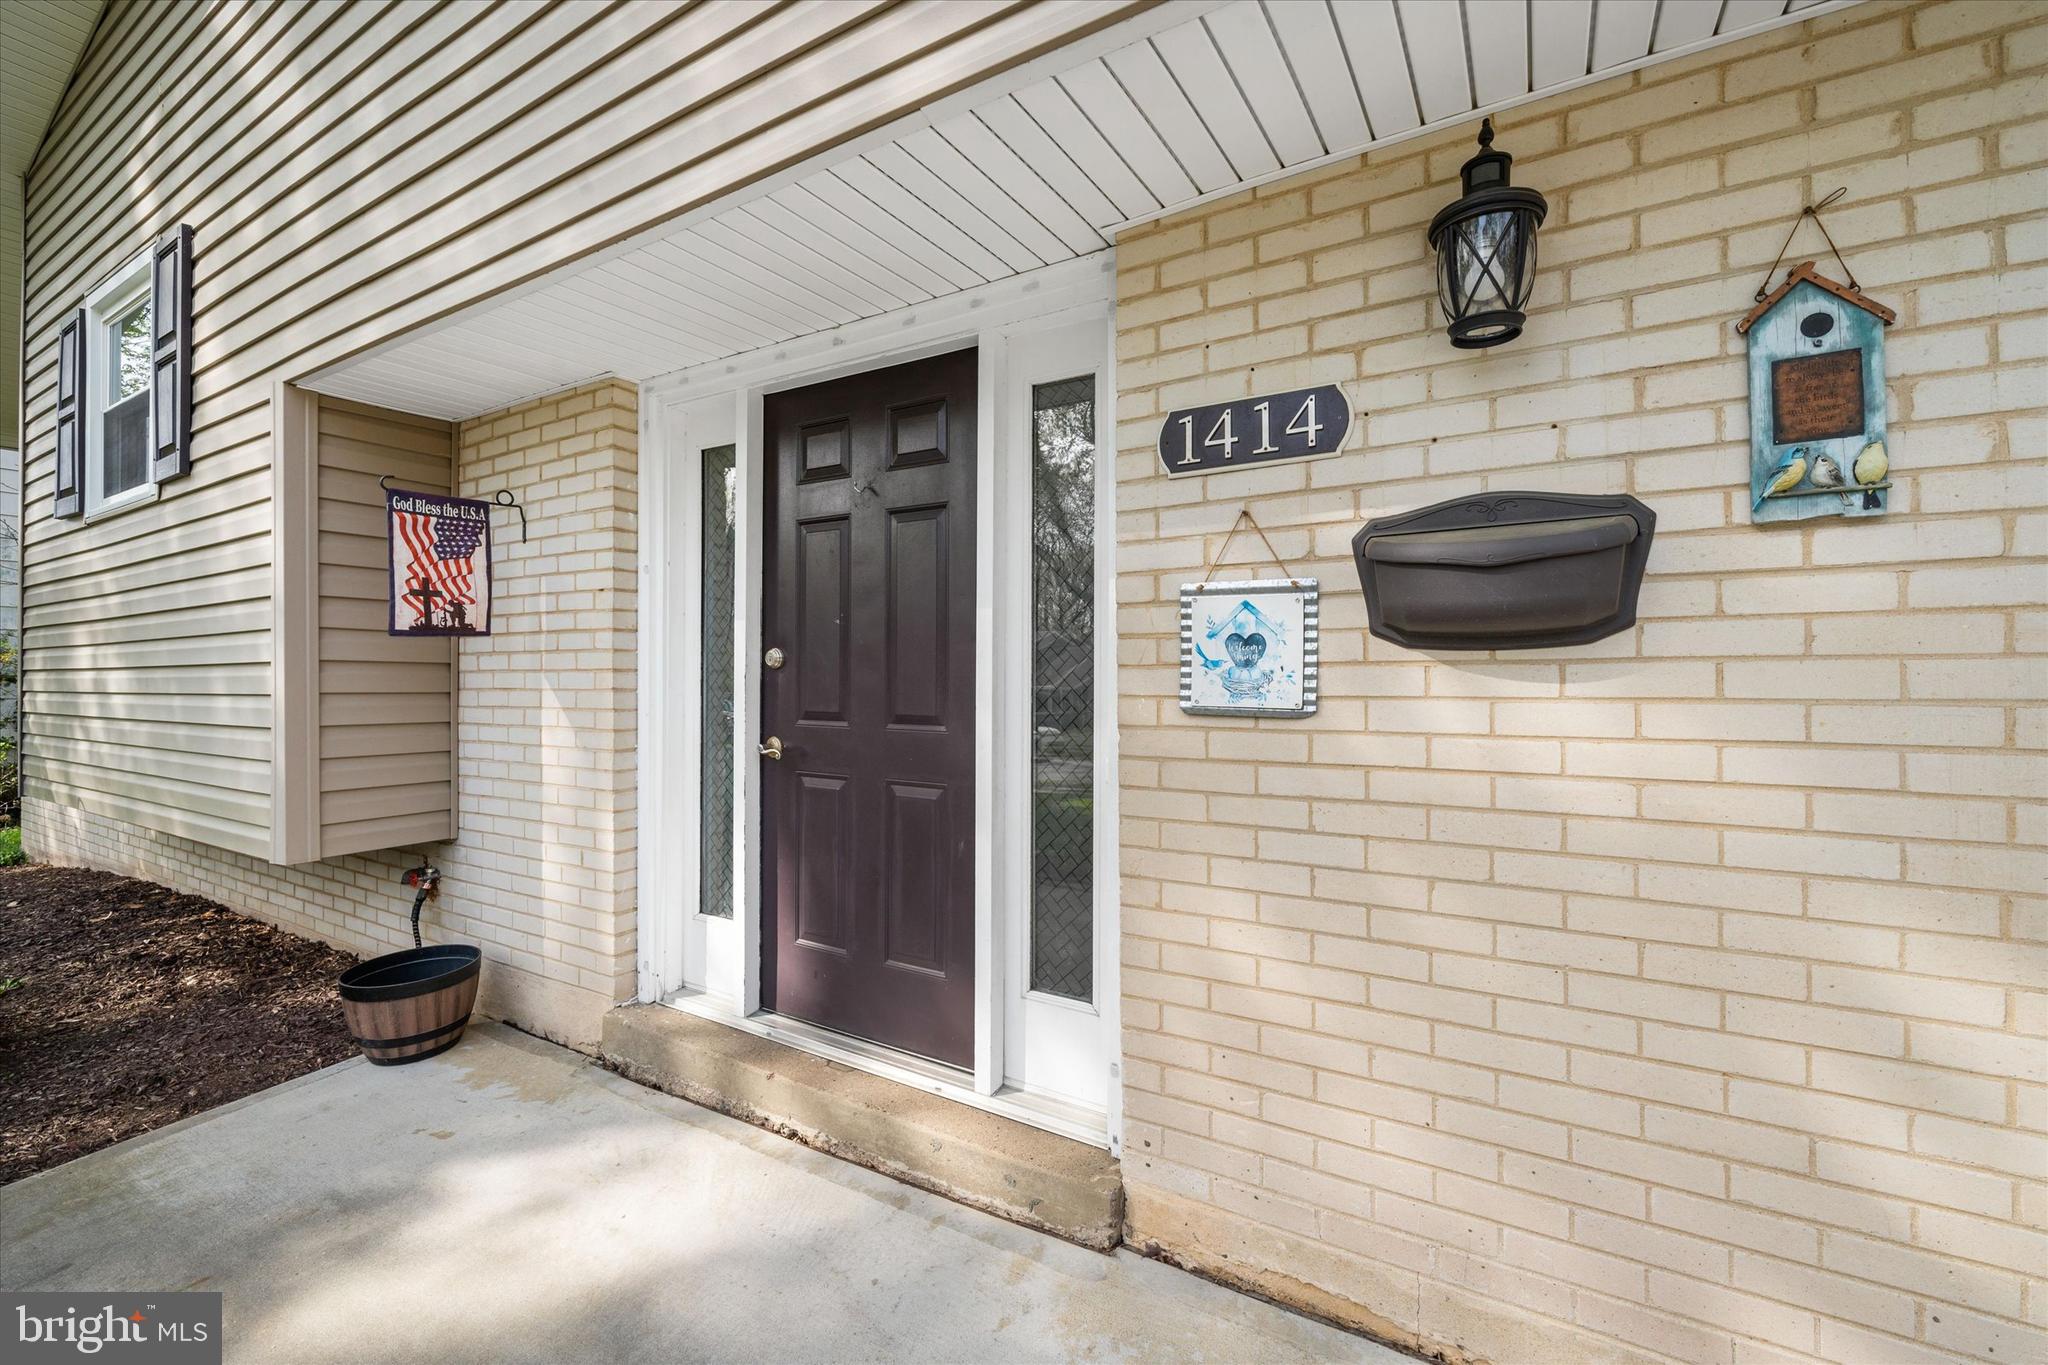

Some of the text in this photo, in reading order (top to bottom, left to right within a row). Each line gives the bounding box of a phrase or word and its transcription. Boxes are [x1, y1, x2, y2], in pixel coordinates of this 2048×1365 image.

[1177, 394, 1324, 465] 1414
[392, 495, 486, 521] God Bless the U.S.A
